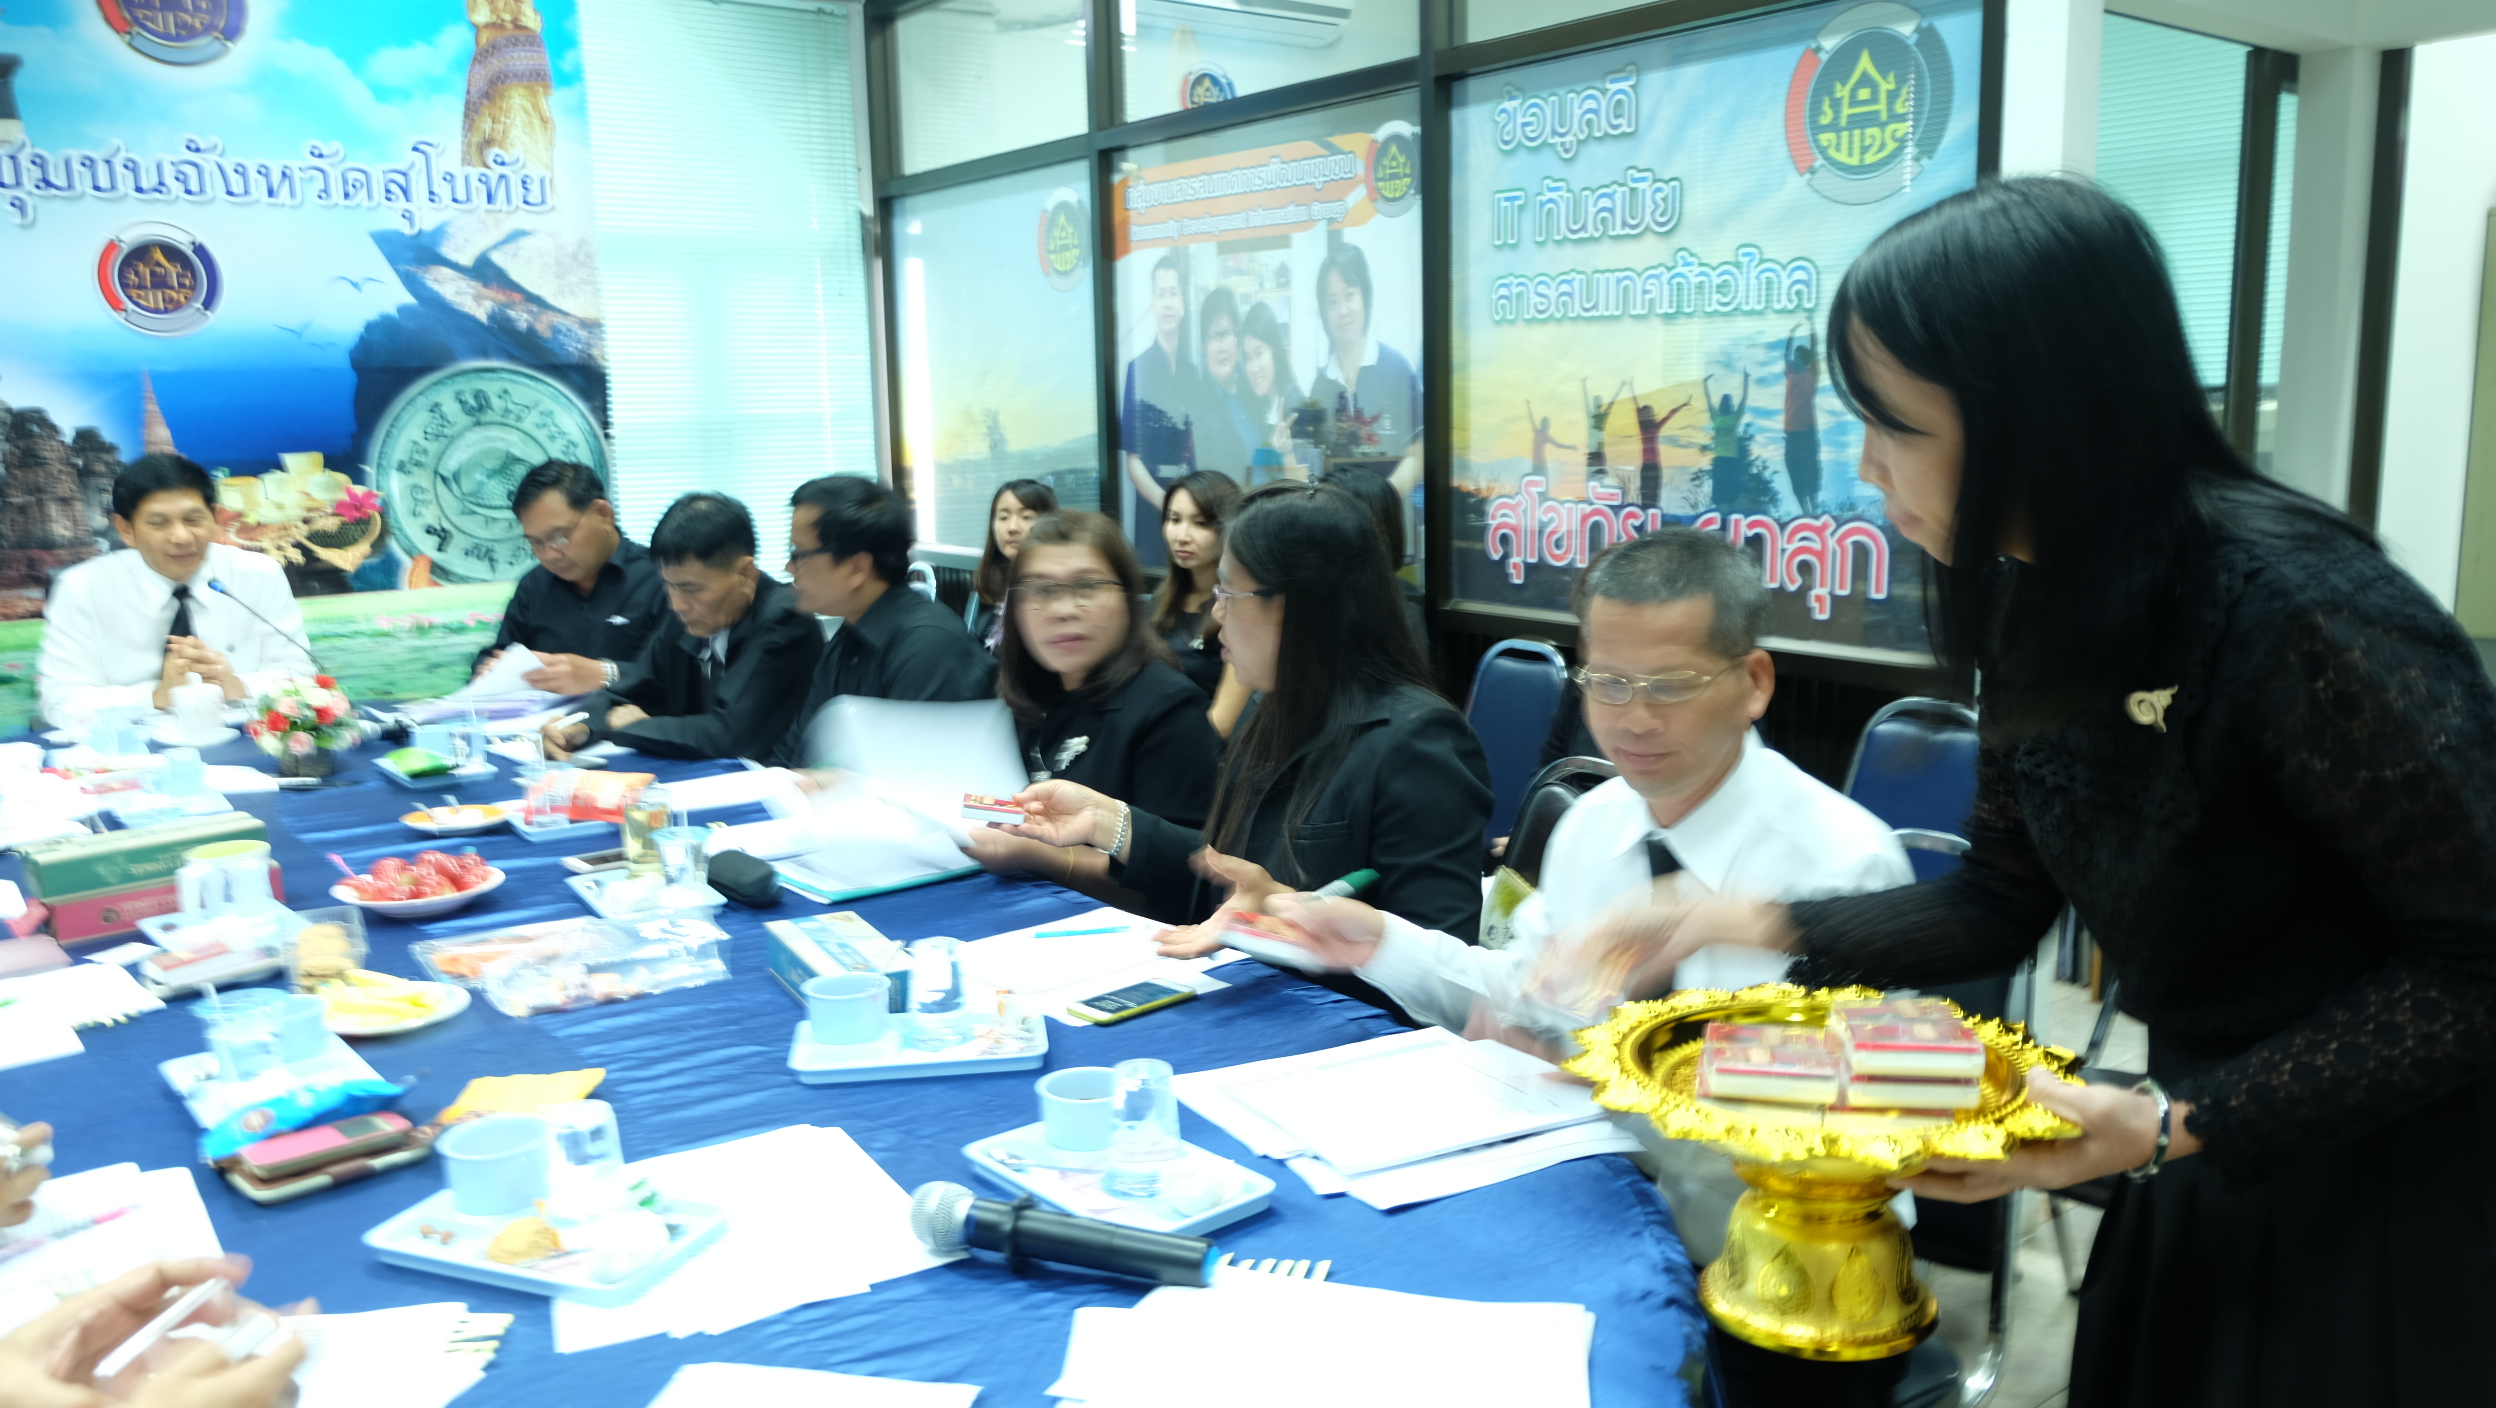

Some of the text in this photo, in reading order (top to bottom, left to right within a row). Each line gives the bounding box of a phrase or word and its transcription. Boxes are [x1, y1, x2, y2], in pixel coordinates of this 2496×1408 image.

[1495, 67, 1637, 158] ข้อมูลดี
[1311, 199, 1348, 223] Group
[1494, 168, 1683, 244] IT ทันสมัย
[1493, 247, 1816, 320] สารสนเทศก้าวไกล
[1692, 512, 1890, 620] าสุก
